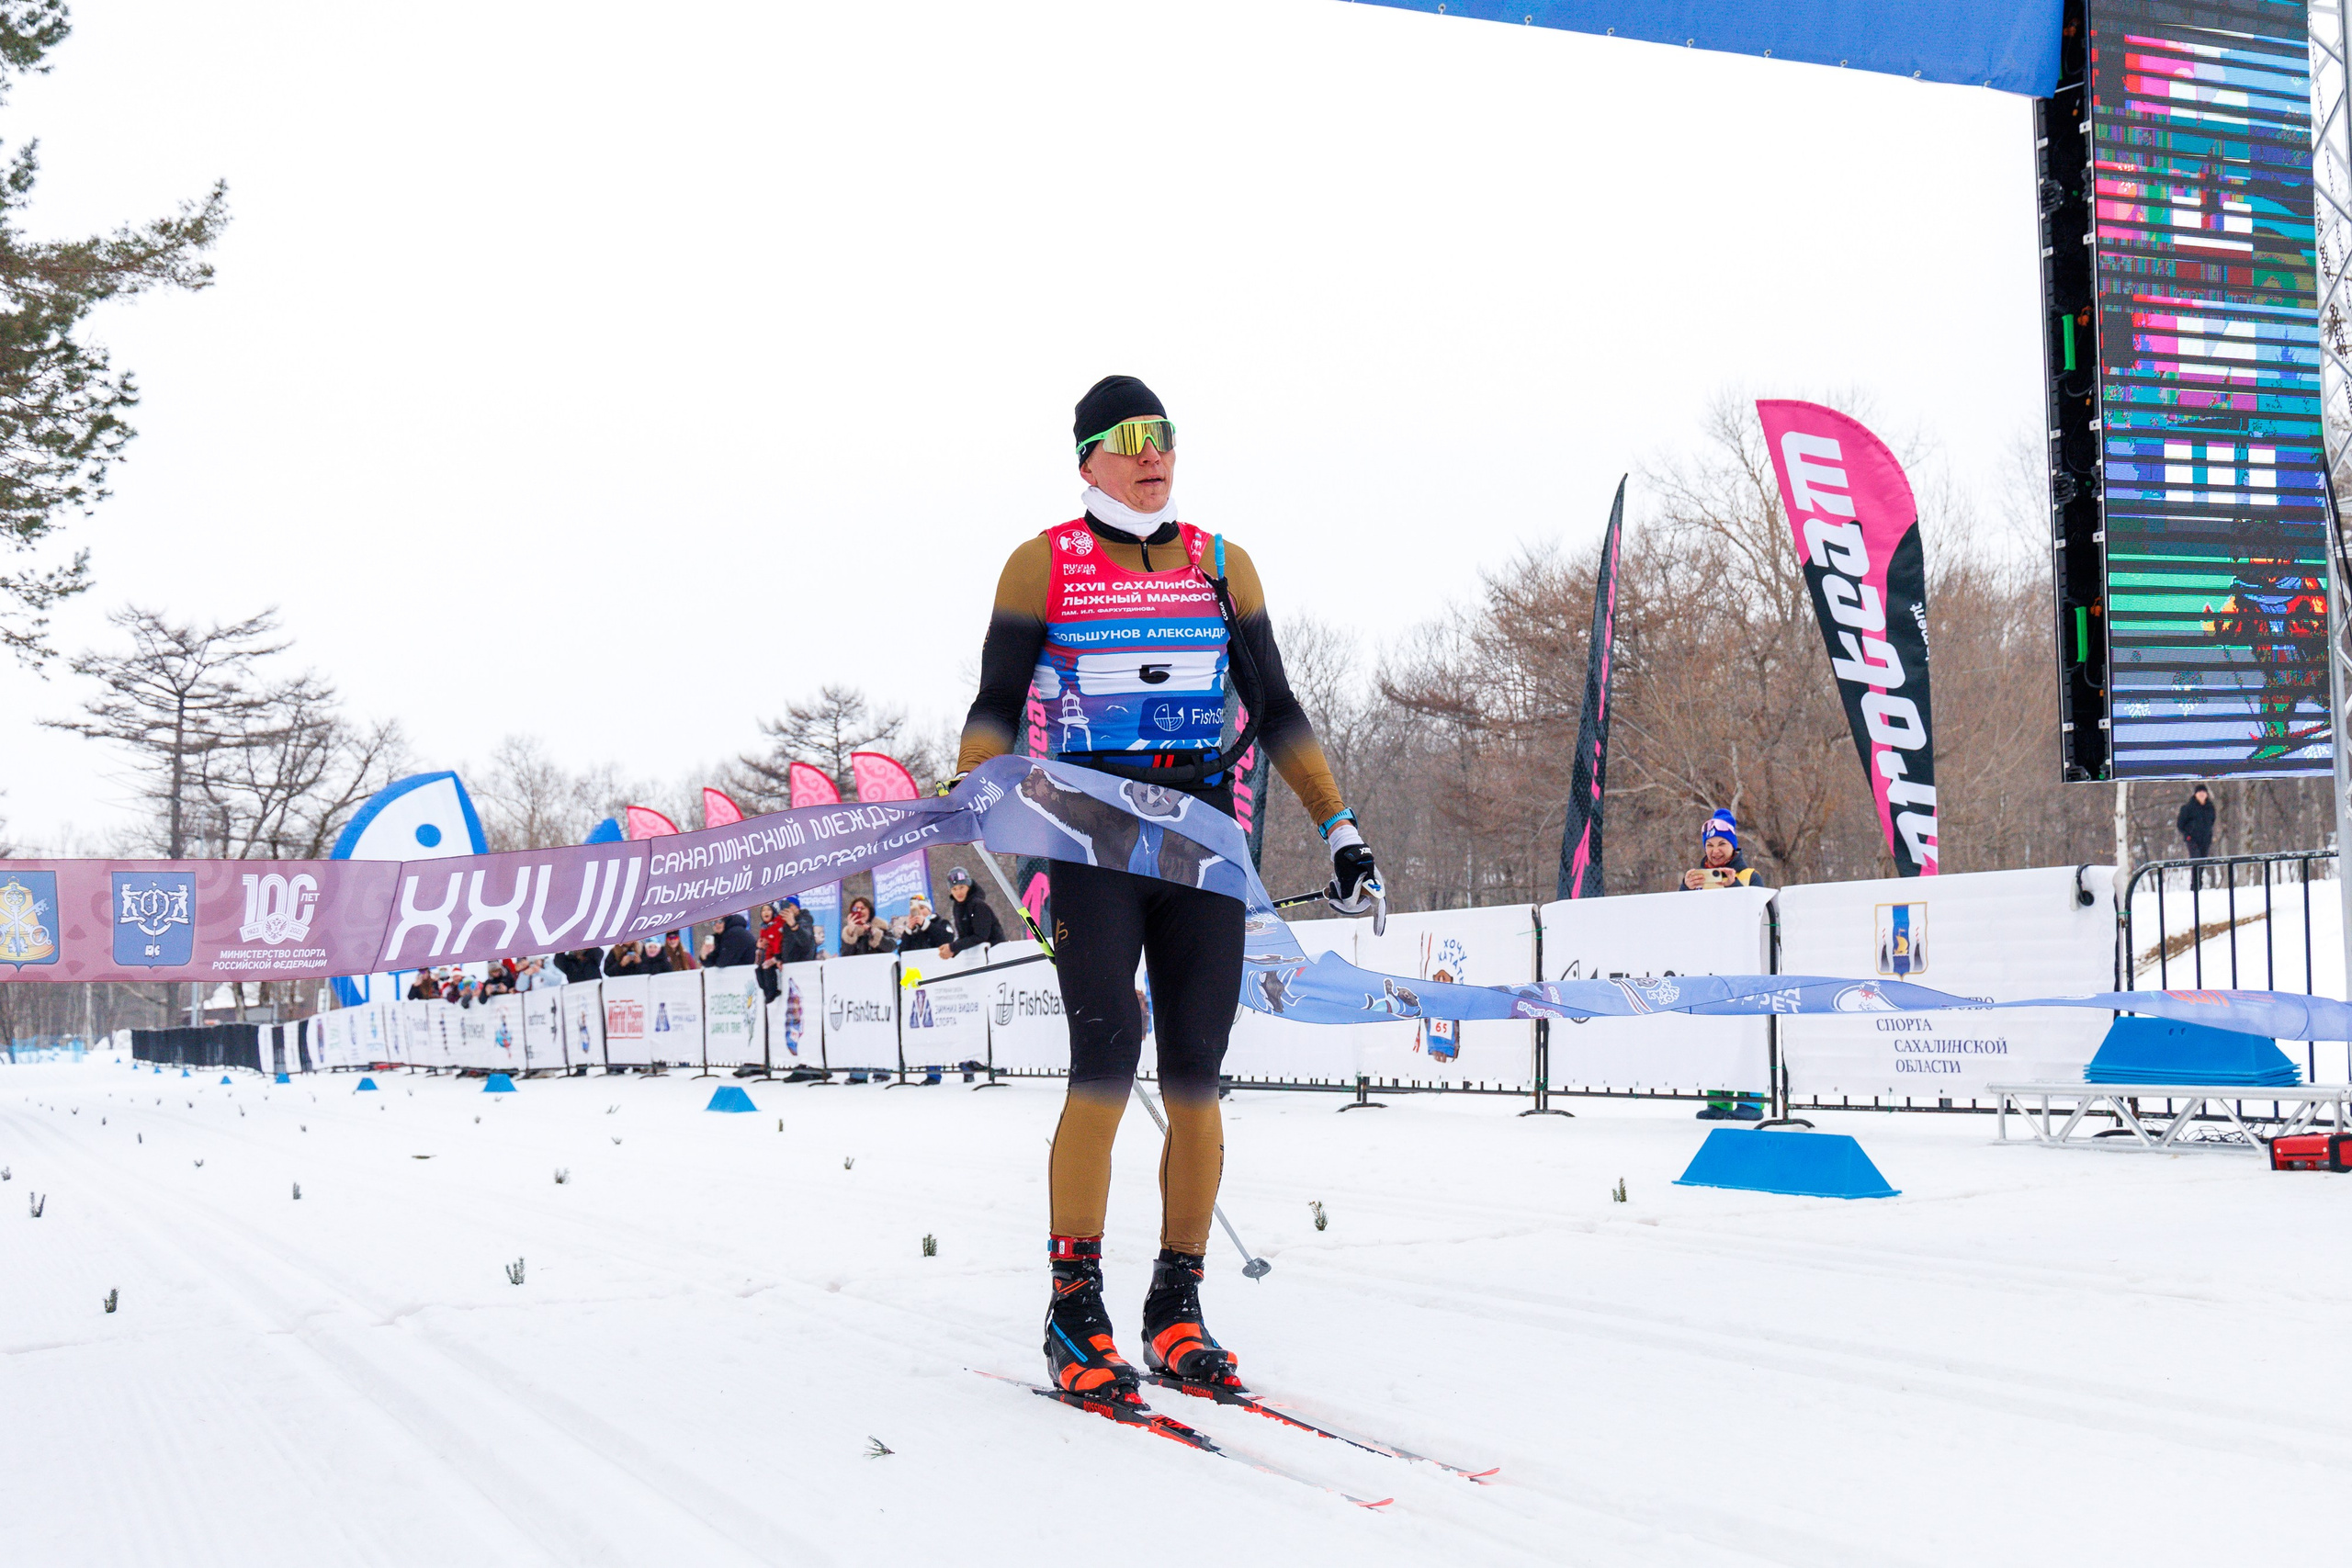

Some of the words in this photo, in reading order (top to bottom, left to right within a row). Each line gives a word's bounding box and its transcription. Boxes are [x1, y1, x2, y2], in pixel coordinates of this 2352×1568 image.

[1063, 582, 1105, 592] XXVII
[1062, 592, 1142, 606] ЛЫЖНЫЙ
[1147, 627, 1227, 639] АЛЕКСАНДР
[1139, 664, 1172, 684] 5
[650, 818, 806, 875] САХАЛИНСКИЙ
[641, 863, 753, 907] ЛЫЖНЫЙ
[300, 893, 320, 902] ЛЕТ
[384, 857, 642, 962] XXVII
[220, 949, 291, 959] МИНИСТЕРСТВО
[292, 949, 326, 958] СПОРТА
[212, 959, 272, 970] РОССИЙСКОЙ
[273, 959, 328, 970] ФЕДЕРАЦИИ
[1435, 1021, 1447, 1033] 65
[1876, 1018, 1933, 1032] СПОРТА
[1894, 1037, 2008, 1055] САХАЛИНСКОЙ
[1895, 1059, 1962, 1074] ОБЛАСТИ
[1083, 1401, 1115, 1421] ROSSIGNOL
